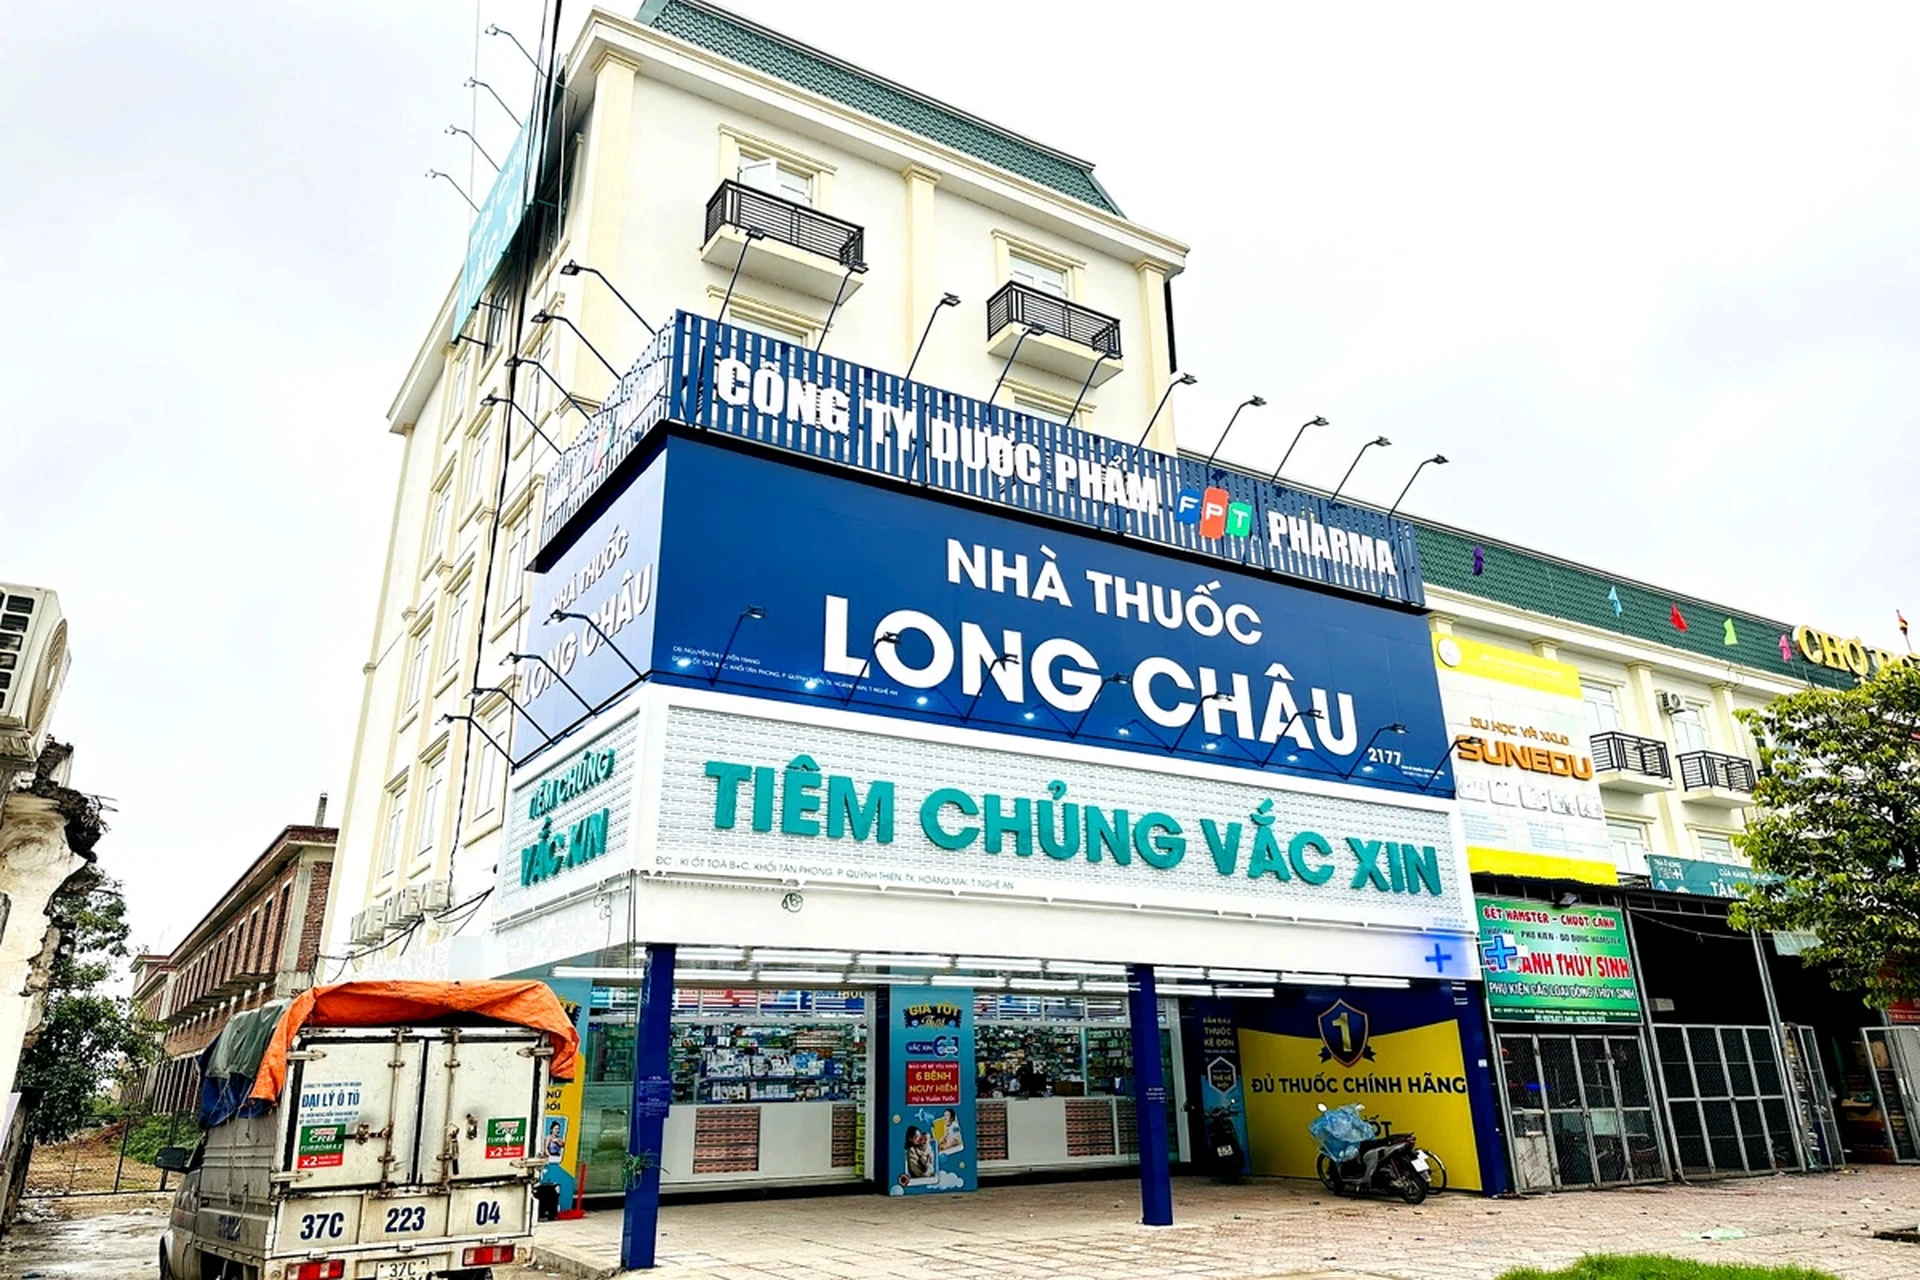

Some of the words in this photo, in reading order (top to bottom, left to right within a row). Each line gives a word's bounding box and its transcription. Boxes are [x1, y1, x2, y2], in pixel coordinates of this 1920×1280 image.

[717, 356, 850, 436] CÔNG
[863, 399, 918, 452] TY
[930, 415, 1042, 493] DƯỢC
[1053, 453, 1159, 517] PHẨM
[1176, 487, 1253, 540] FPT
[1268, 511, 1397, 577] PHARMA
[547, 572, 577, 610] NHÀ
[580, 524, 629, 595] THUỐC
[947, 539, 1073, 608] NHÀ
[1085, 568, 1262, 645] THUỐC
[521, 631, 578, 709] LONG
[581, 562, 654, 658] CHÂU
[1794, 624, 1869, 682] CHỢ
[823, 594, 1101, 714] LONG
[1131, 656, 1359, 756] CHÂU
[1470, 715, 1488, 731] DU
[1491, 720, 1517, 737] HỌC
[1520, 724, 1537, 740] VÀ
[1367, 746, 1402, 766] 2177
[1454, 733, 1594, 781] SUNEDU
[528, 778, 559, 820] TIÊM
[555, 748, 617, 803] CHỦNG
[704, 753, 896, 845] TIÊM
[919, 778, 1187, 870] CHỦNG
[1200, 797, 1336, 887] VẮC
[1345, 836, 1443, 896] XIN
[520, 815, 566, 887] VẮC
[563, 807, 611, 869] XIN
[707, 858, 727, 870] TOÀ
[754, 860, 777, 873] KHỐI
[1504, 908, 1550, 924] HAMSTER
[1596, 955, 1630, 978] SINH
[1509, 981, 1530, 998] KIỆN
[1616, 988, 1636, 999] SINH
[909, 1002, 932, 1016] GIÁ
[935, 1002, 960, 1017] TỐT
[1332, 1011, 1352, 1052] 1
[908, 1084, 935, 1093] NGUY
[935, 1081, 958, 1092] HIỂM
[915, 1071, 923, 1080] 6
[924, 1069, 952, 1082] BỆNH
[1250, 1072, 1276, 1093] ĐỦ
[1279, 1071, 1339, 1093] THUỐC
[1342, 1072, 1402, 1094] CHÍNH
[1408, 1071, 1467, 1094] HÃNG
[301, 1093, 320, 1111] ĐẠI
[322, 1089, 335, 1107] LÝ
[337, 1089, 345, 1107] Ô
[347, 1088, 360, 1107] TÔ
[302, 1156, 318, 1167] x2
[489, 1147, 503, 1157] x2
[300, 1211, 344, 1241] 37C
[384, 1206, 427, 1233] 223
[476, 1201, 501, 1226] 04
[390, 1261, 416, 1278] 37C
